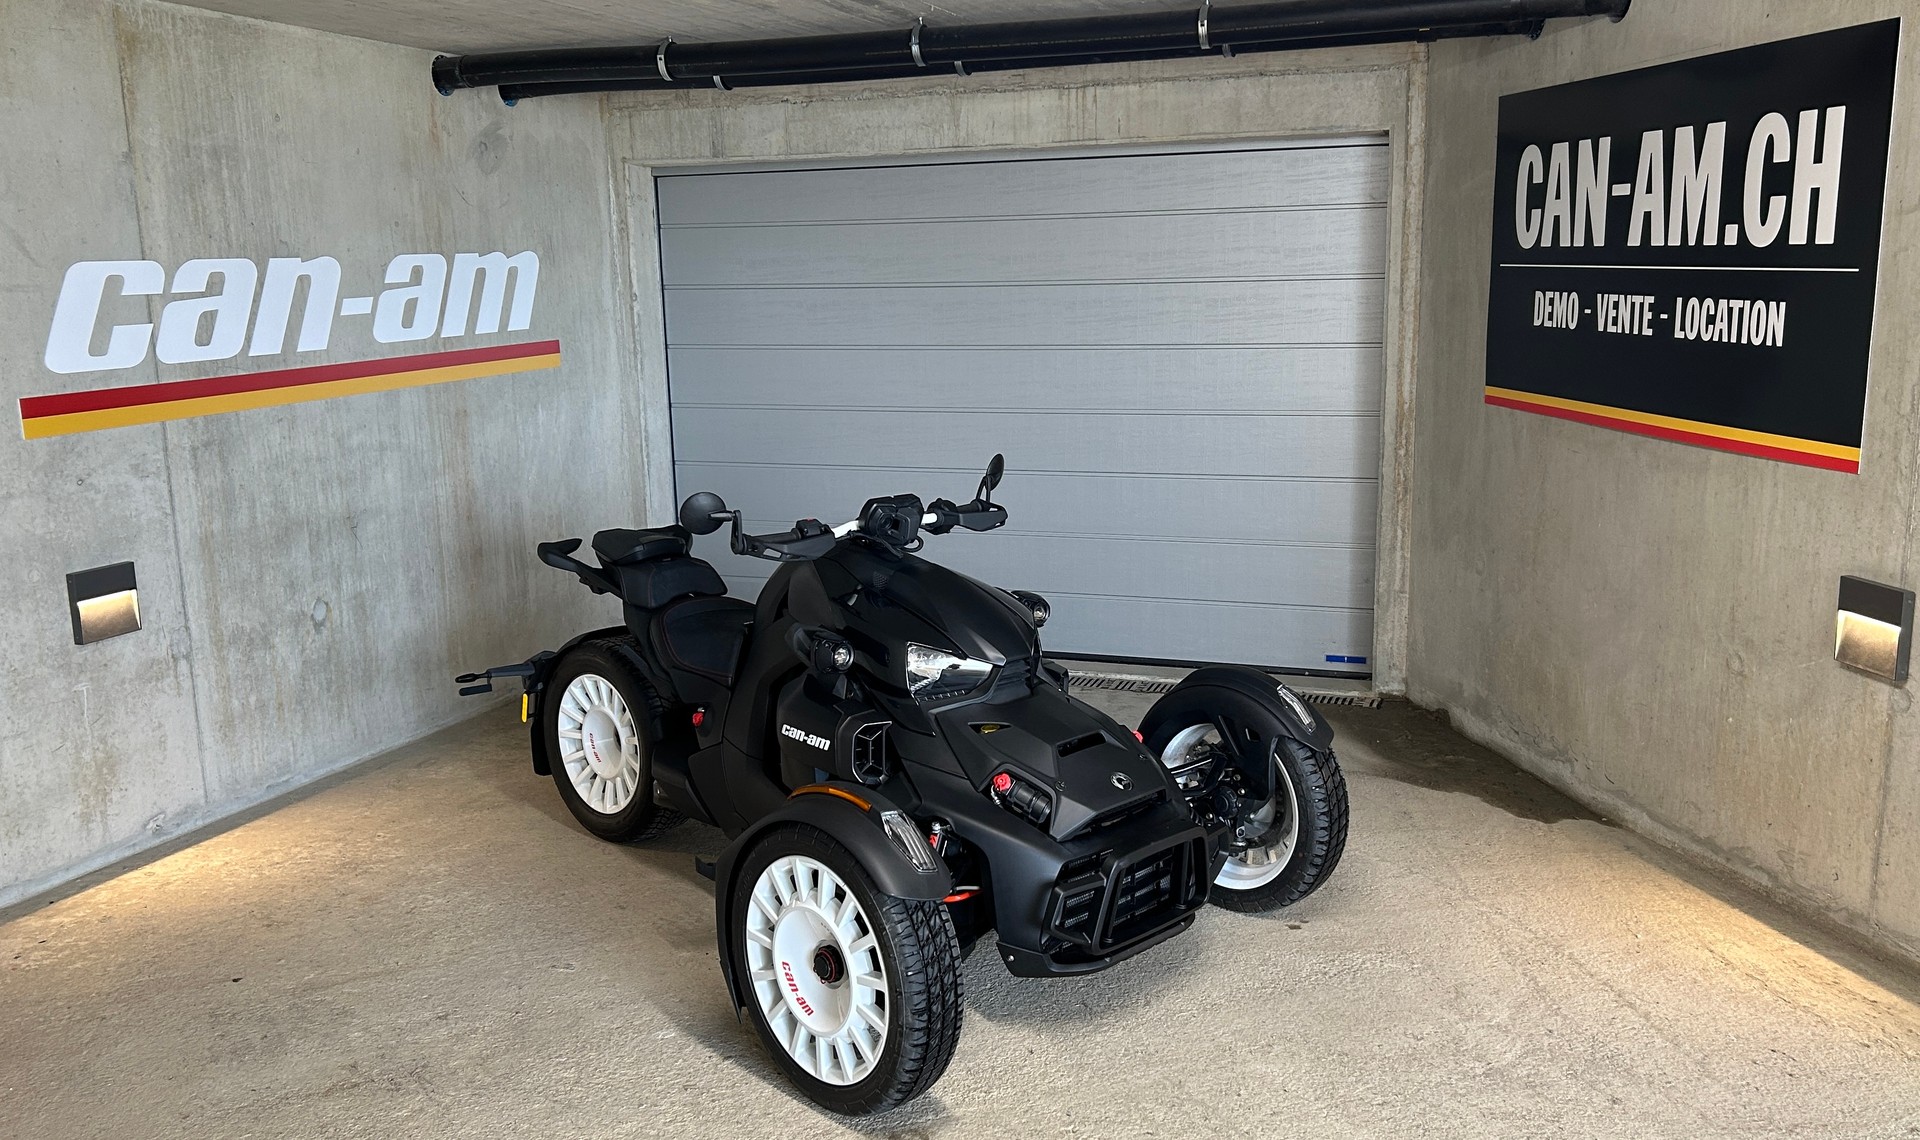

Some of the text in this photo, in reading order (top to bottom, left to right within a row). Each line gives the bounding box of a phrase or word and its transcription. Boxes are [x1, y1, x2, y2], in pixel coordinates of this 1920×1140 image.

[1515, 106, 1846, 248] CAN-AM.CH
[44, 250, 540, 375] can-am
[1533, 290, 1579, 330] DEMO
[1597, 293, 1655, 336] VENTE
[1674, 297, 1786, 347] LOCATION
[781, 723, 831, 751] can-am
[781, 961, 815, 1016] can-am
